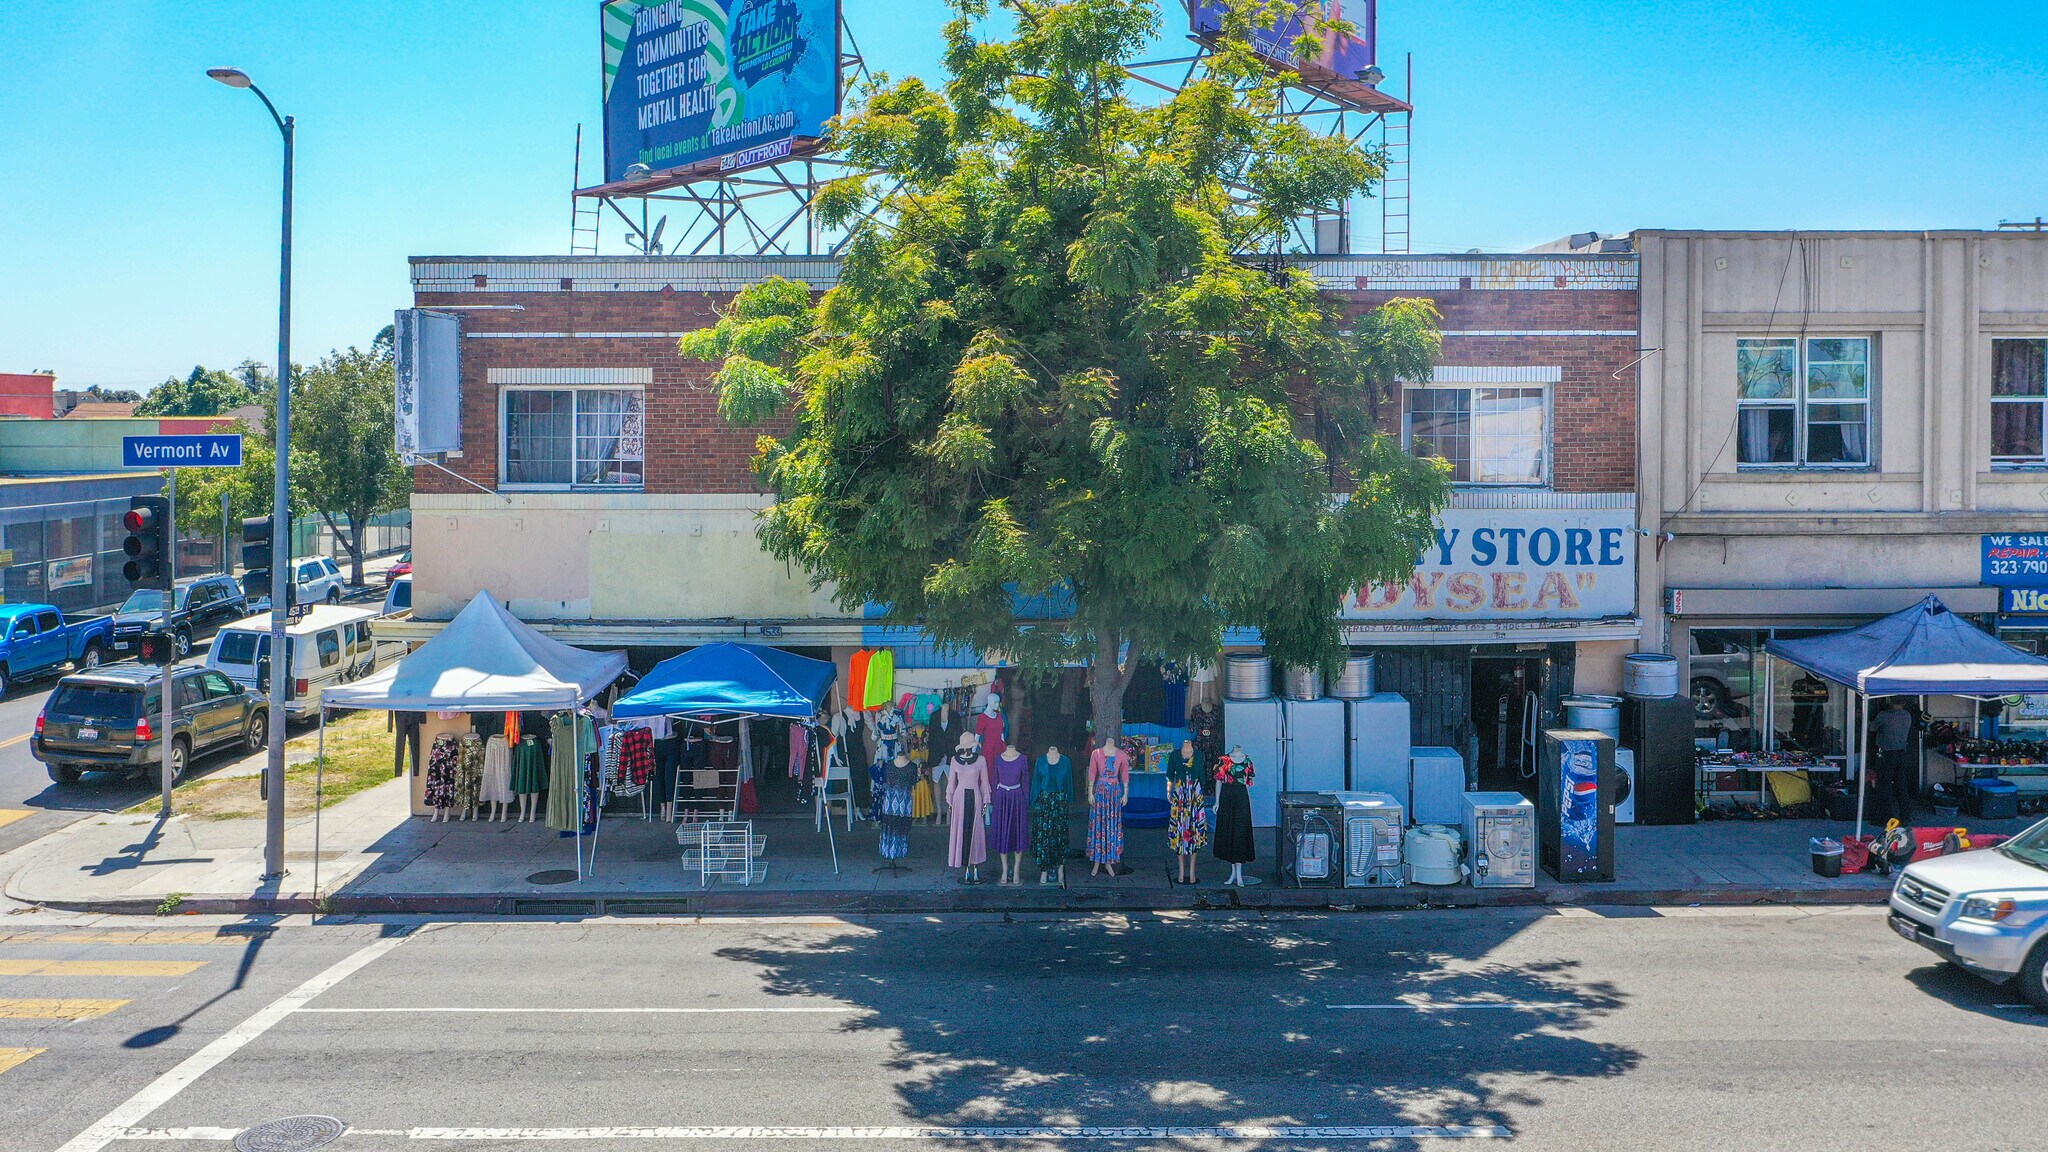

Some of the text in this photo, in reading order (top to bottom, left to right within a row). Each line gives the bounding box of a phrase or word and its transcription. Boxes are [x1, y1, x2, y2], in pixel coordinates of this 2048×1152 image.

[636, 0, 683, 37] BRINGING
[739, 0, 777, 37] TAKE
[636, 20, 709, 68] COMMUNITIES
[738, 16, 794, 59] ACTION
[750, 52, 771, 68] MENTAL
[771, 42, 793, 58] HEALTH
[637, 54, 708, 99] TOGETHER FOR
[769, 51, 792, 67] COUNTY
[638, 84, 717, 131] MENTAL HEALTH
[654, 142, 673, 161] local
[674, 136, 699, 155] events
[711, 110, 794, 147] TakeActionLAC.com
[738, 141, 789, 166] OUTFRONT
[134, 442, 230, 458] Vermont Av
[1470, 527, 1624, 567] STORE
[1988, 547, 2040, 559] REPAIR
[1990, 536, 2012, 547] WE
[1561, 774, 1575, 818] PEPSI
